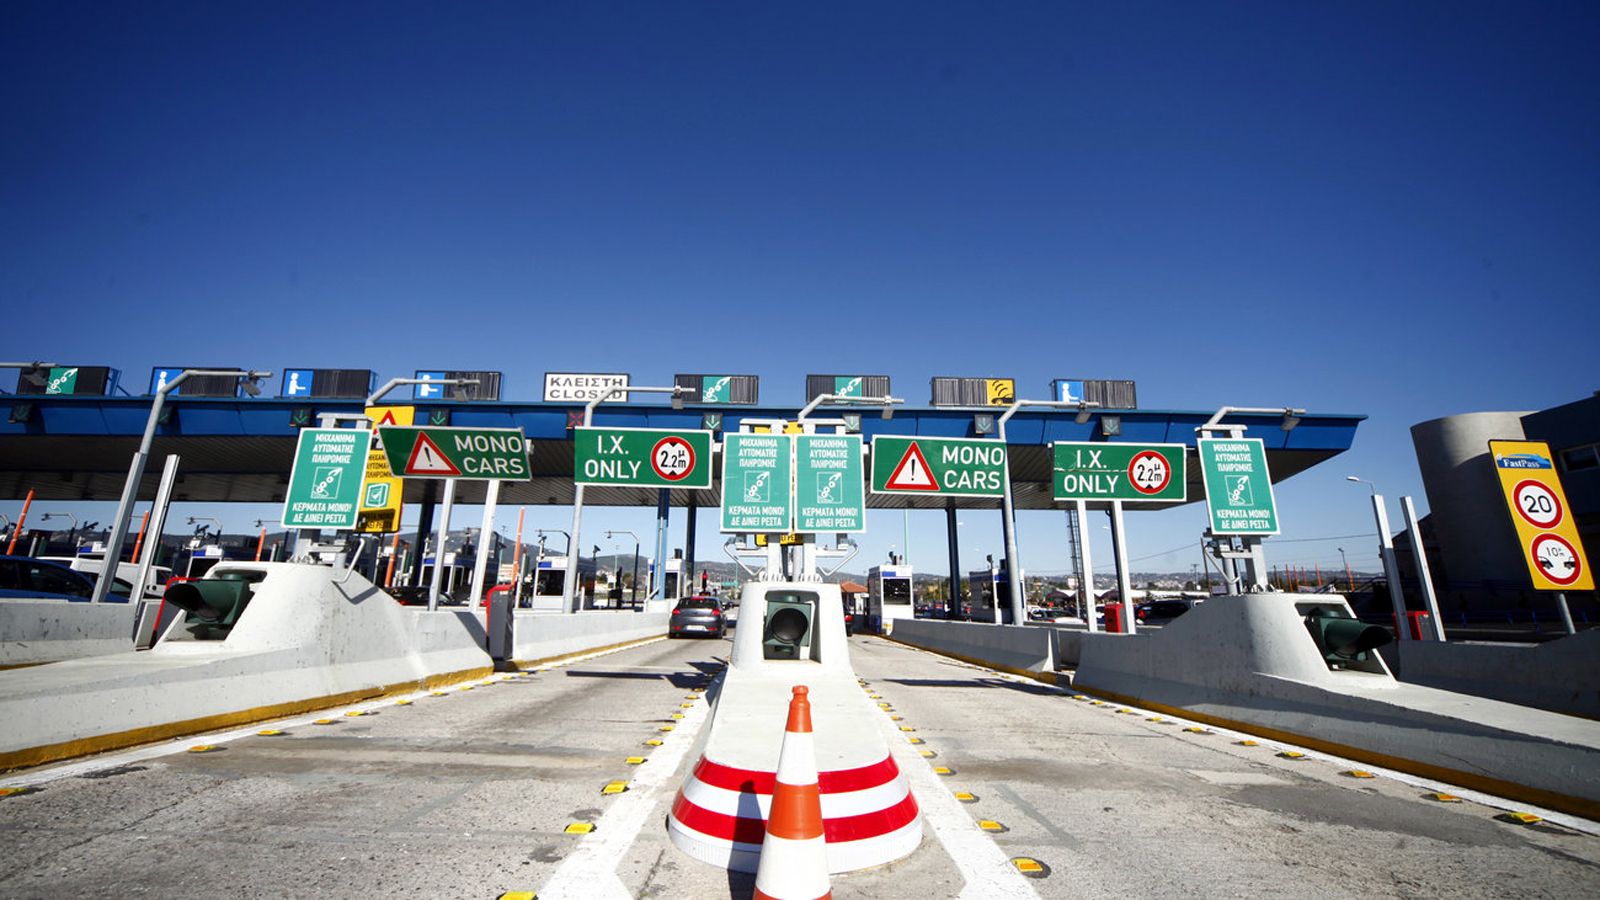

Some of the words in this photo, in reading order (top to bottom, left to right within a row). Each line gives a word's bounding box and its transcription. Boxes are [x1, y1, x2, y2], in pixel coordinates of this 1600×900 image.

[550, 377, 623, 387] ΚΛΕΙΣΤΗ
[550, 389, 623, 399] CLOSD
[739, 438, 778, 448] ΜΗΧΑΝΗΜΑ
[810, 439, 848, 449] ΜΗΧΑΝΗΜΑ
[738, 448, 777, 458] ΑΥΤΟΜΑΤΗΣ
[810, 449, 849, 459] ΑΥΤΟΜΑΤΗΣ
[463, 457, 525, 475] CARS
[1503, 459, 1540, 468] FastPass
[584, 459, 642, 479] ONLY
[943, 470, 1001, 490] CARS
[1063, 474, 1119, 494] ONLY
[1524, 495, 1552, 513] 20
[729, 505, 761, 515] ΚΕΡΜΑΤΑ
[802, 507, 834, 516] ΚΕΡΜΑΤΑ
[731, 516, 741, 526] ΔΕ
[742, 516, 760, 526] ΔΙΝΕΙ
[761, 516, 782, 526] ΡΕΣΤΑ
[805, 518, 816, 527] ΔΕ
[816, 518, 834, 527] ΔΙΝΕΙ
[835, 518, 856, 528] ΡΕΣΤΑ
[1546, 547, 1559, 557] 10
